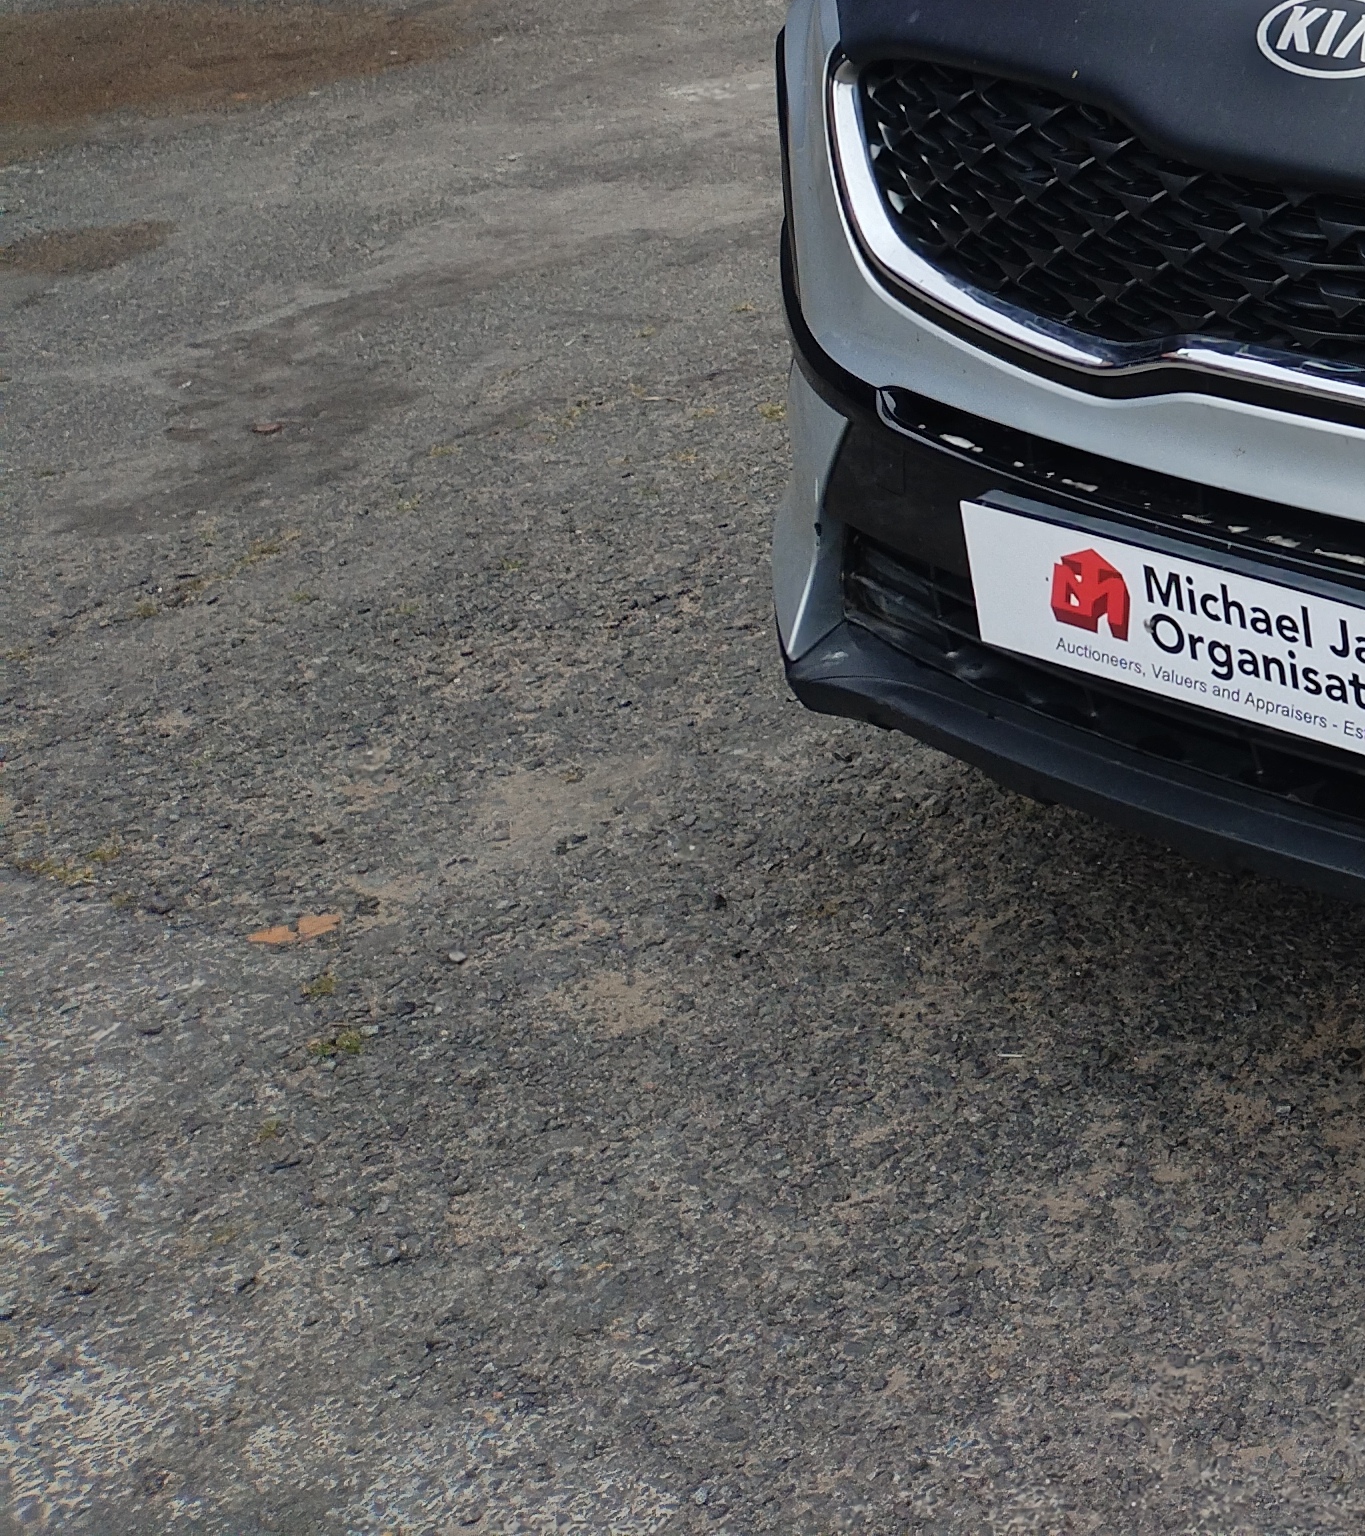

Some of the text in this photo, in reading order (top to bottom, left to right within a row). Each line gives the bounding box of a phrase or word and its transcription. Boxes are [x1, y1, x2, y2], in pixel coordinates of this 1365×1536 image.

[1143, 564, 1313, 648] Michael
[1056, 637, 1146, 677] Auctioneers,
[1152, 663, 1207, 693] Valuers
[1212, 683, 1240, 703] and
[1244, 691, 1328, 729] Appraisers
